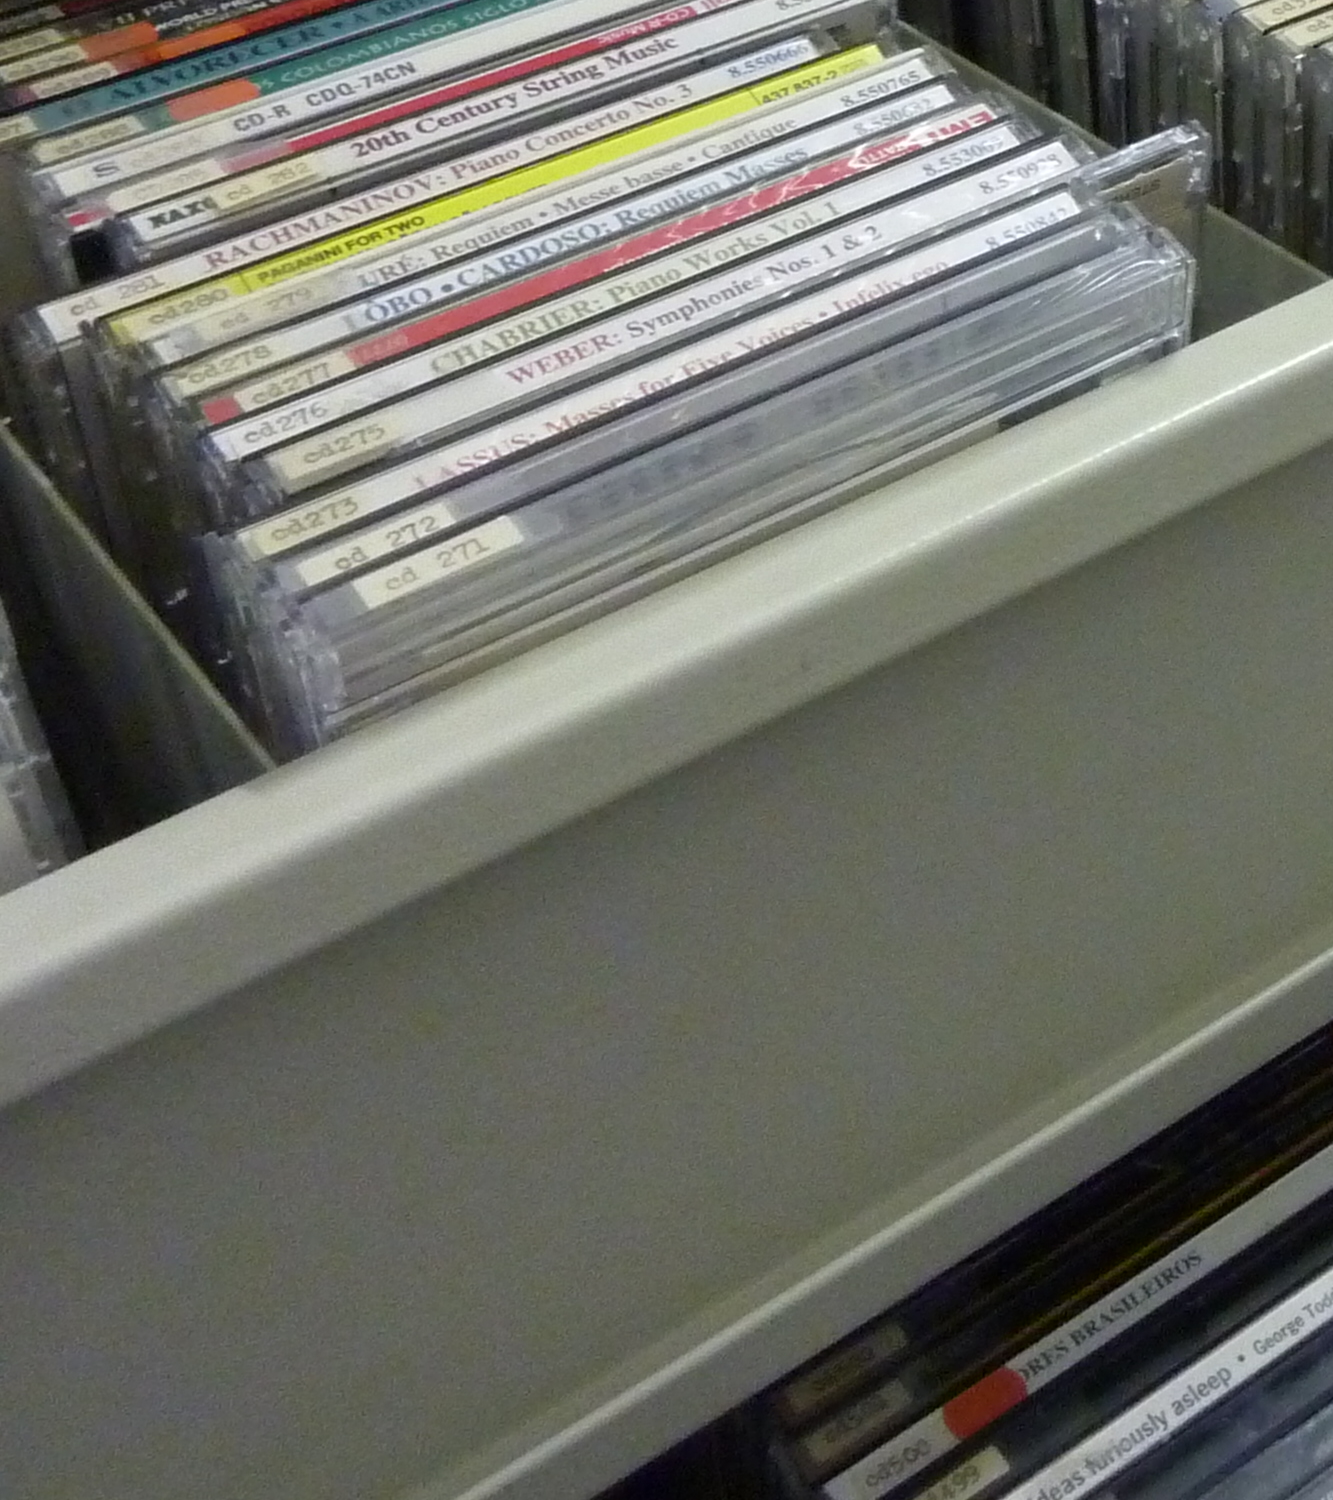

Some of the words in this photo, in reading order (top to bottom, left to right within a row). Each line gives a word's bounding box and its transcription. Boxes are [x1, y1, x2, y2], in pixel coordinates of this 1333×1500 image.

[280, 19, 459, 84] COLOMBIANOS
[598, 24, 646, 45] Music
[651, 5, 693, 29] CD-R
[233, 103, 292, 132] CD-R
[305, 61, 417, 108] CDQ-74CN
[350, 129, 412, 158] 20th
[415, 90, 519, 135] Century
[522, 60, 606, 99] String
[604, 35, 679, 70] Music
[69, 296, 97, 316] cd
[116, 276, 165, 298] 281
[202, 173, 449, 272] RACHMANINOV:
[450, 149, 520, 181] Piano
[524, 107, 631, 153] Concerto
[636, 93, 674, 114] No.
[679, 84, 693, 100] 3
[433, 217, 535, 260] Requiem
[552, 182, 618, 215] Messe
[622, 159, 684, 188] basse
[701, 116, 797, 162] Cantique
[839, 69, 922, 107] 8.550765
[455, 222, 612, 289] CARDOSO:
[616, 186, 718, 231] Requiem
[724, 145, 810, 193] Masses
[149, 288, 228, 324] cd280
[255, 244, 343, 284] PAGANINI
[344, 231, 384, 252] FOR
[384, 215, 426, 237] TWO
[251, 362, 332, 404] cd277
[430, 297, 605, 375] CHABRIER:
[608, 260, 682, 303] Piano
[682, 227, 770, 274] Works
[770, 211, 823, 245] Vol.
[824, 201, 841, 217] 1
[243, 399, 329, 444] cd276
[507, 332, 623, 386] WEBER:
[625, 268, 765, 338] Symphonies
[764, 252, 821, 284] Nos.
[822, 243, 838, 259] 1
[841, 233, 863, 252] &
[863, 224, 883, 243] 2
[302, 423, 385, 465] cd275
[545, 393, 635, 435] Masses
[636, 374, 676, 405] for
[735, 315, 819, 358] Voices
[269, 498, 360, 544] cd273
[333, 549, 370, 572] cd
[385, 515, 442, 547] 272
[384, 566, 420, 592] cd
[435, 538, 492, 569] 271
[1070, 1248, 1204, 1346] BRASILEIROS
[1084, 1403, 1170, 1476] furiously
[1169, 1365, 1234, 1419] asleep
[1250, 1312, 1310, 1358] George
